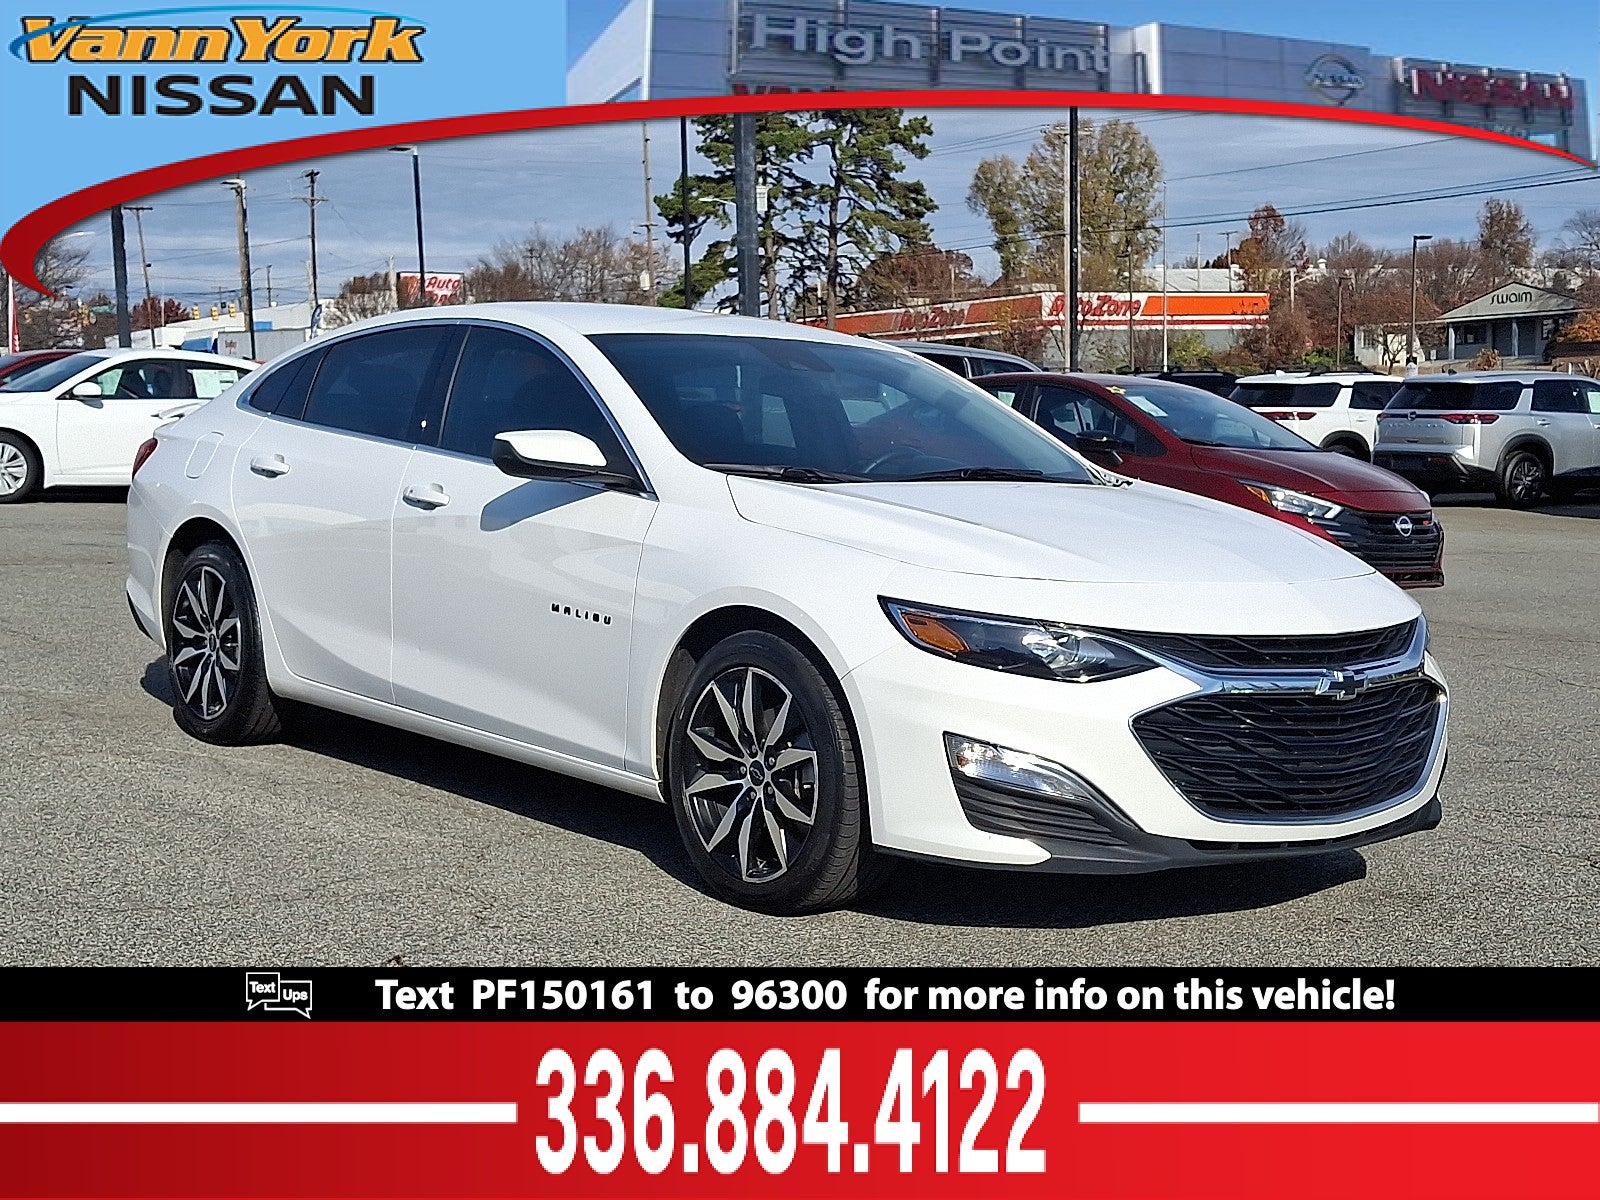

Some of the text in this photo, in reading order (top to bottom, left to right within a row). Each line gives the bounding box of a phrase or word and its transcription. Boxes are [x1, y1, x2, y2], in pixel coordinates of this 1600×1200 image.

[426, 276, 461, 289] Auto
[1049, 295, 1141, 316] AoZone
[551, 603, 612, 625] MALIBU
